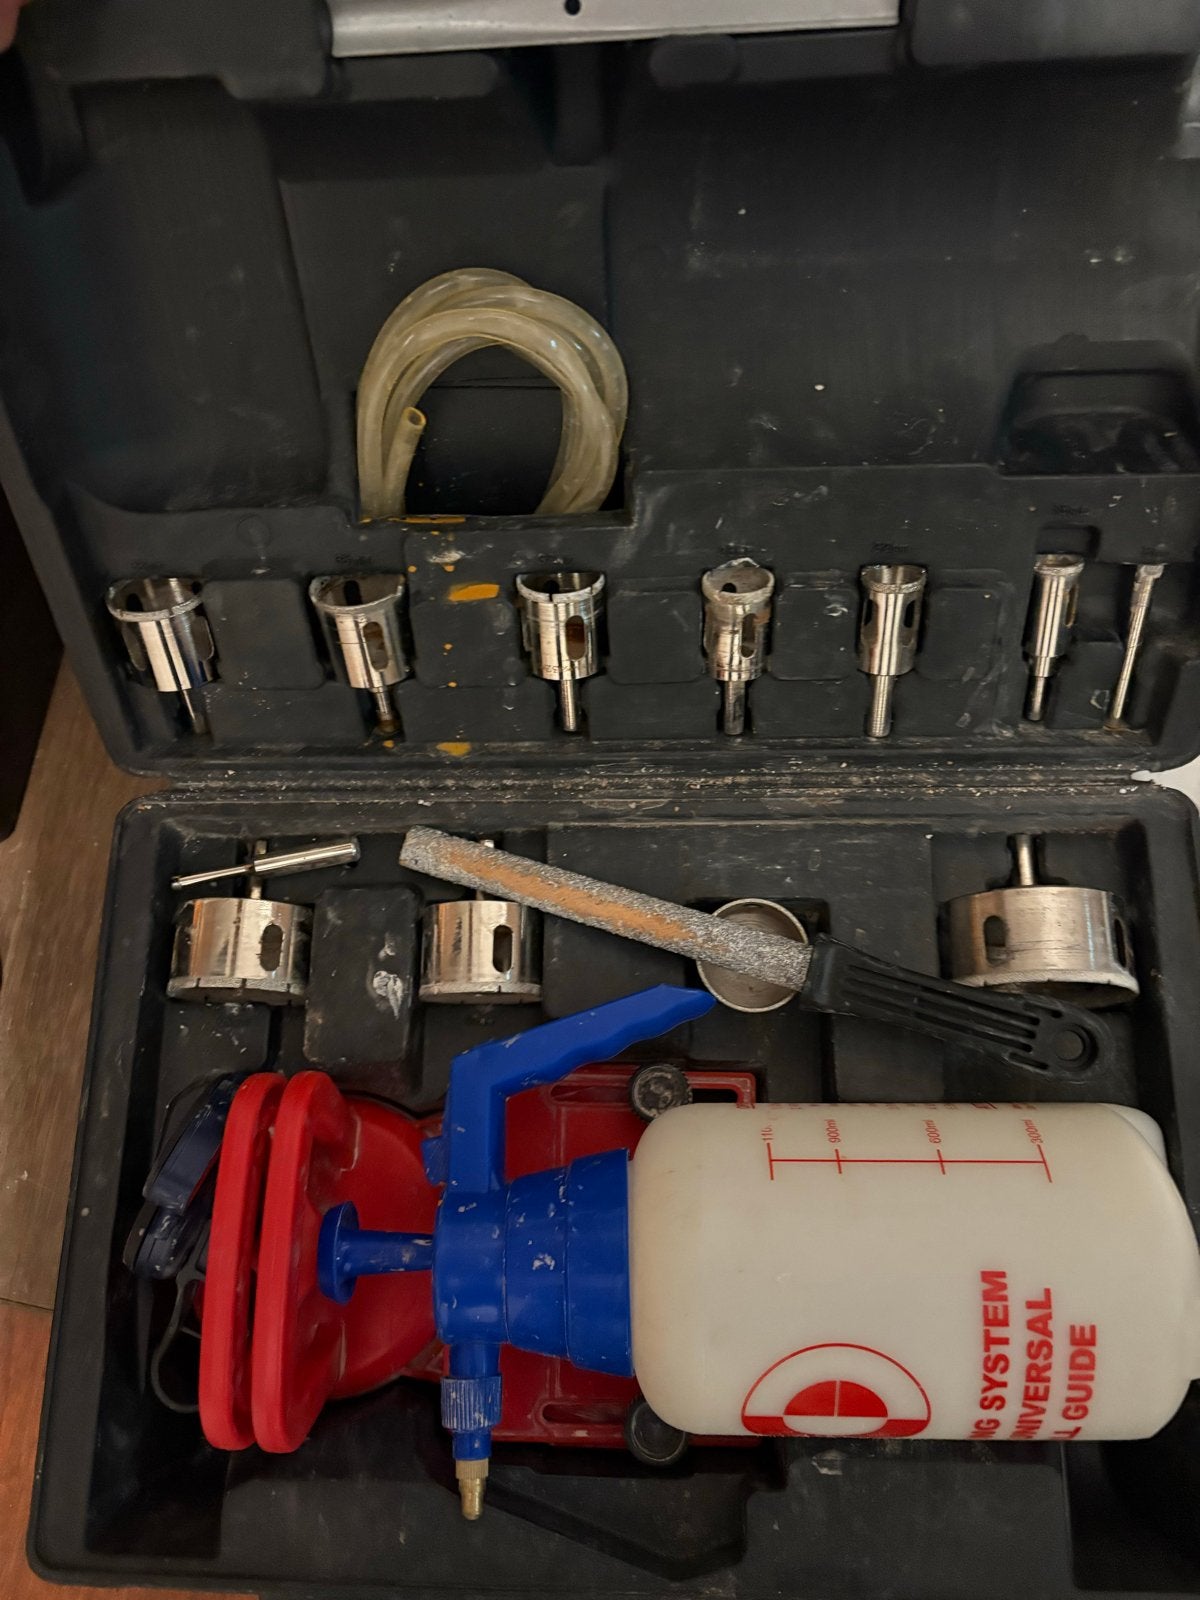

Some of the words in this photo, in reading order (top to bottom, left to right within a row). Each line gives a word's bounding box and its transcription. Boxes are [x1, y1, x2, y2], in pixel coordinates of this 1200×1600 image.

[824, 1118, 841, 1144] 900ml
[922, 1118, 942, 1144] 600ml
[1020, 1118, 1044, 1144] 300ml
[979, 1270, 1010, 1411] SYSTEM
[1061, 1324, 1097, 1421] GUIDE
